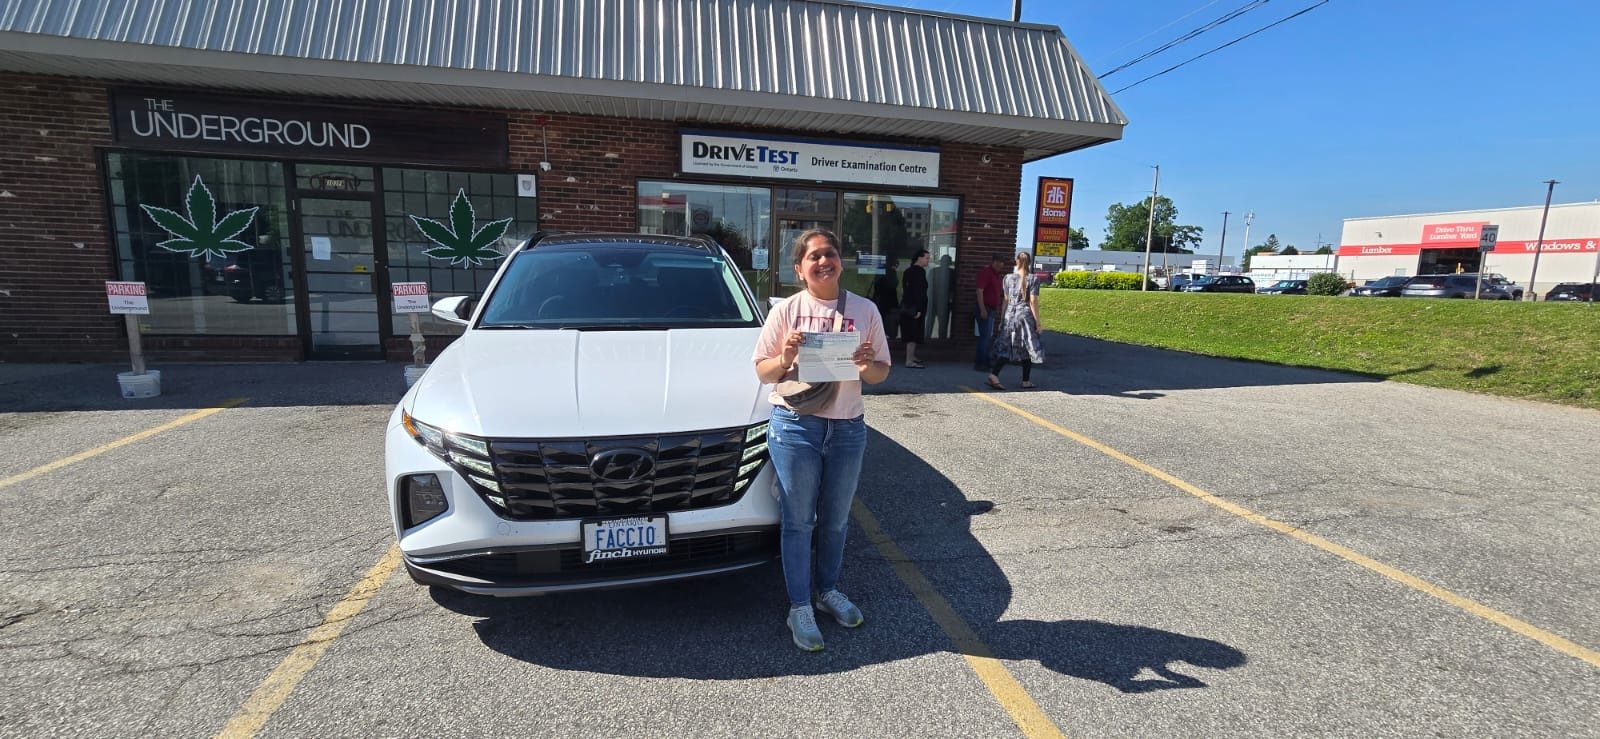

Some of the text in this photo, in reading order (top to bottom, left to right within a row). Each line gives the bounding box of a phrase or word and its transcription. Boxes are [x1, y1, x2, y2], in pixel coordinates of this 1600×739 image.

[144, 98, 174, 112] THE
[130, 110, 371, 149] UNDERGROUND
[811, 156, 927, 174] Driver Examination Centre
[1042, 207, 1066, 217] Home
[1481, 232, 1496, 243] 40
[1361, 246, 1393, 254] Lumber
[1525, 240, 1597, 251] Wndows &
[107, 284, 146, 296] PARKING
[393, 284, 427, 295] PARKING
[596, 526, 655, 550] FACCIO
[585, 547, 667, 564] finch HYUNDAI
